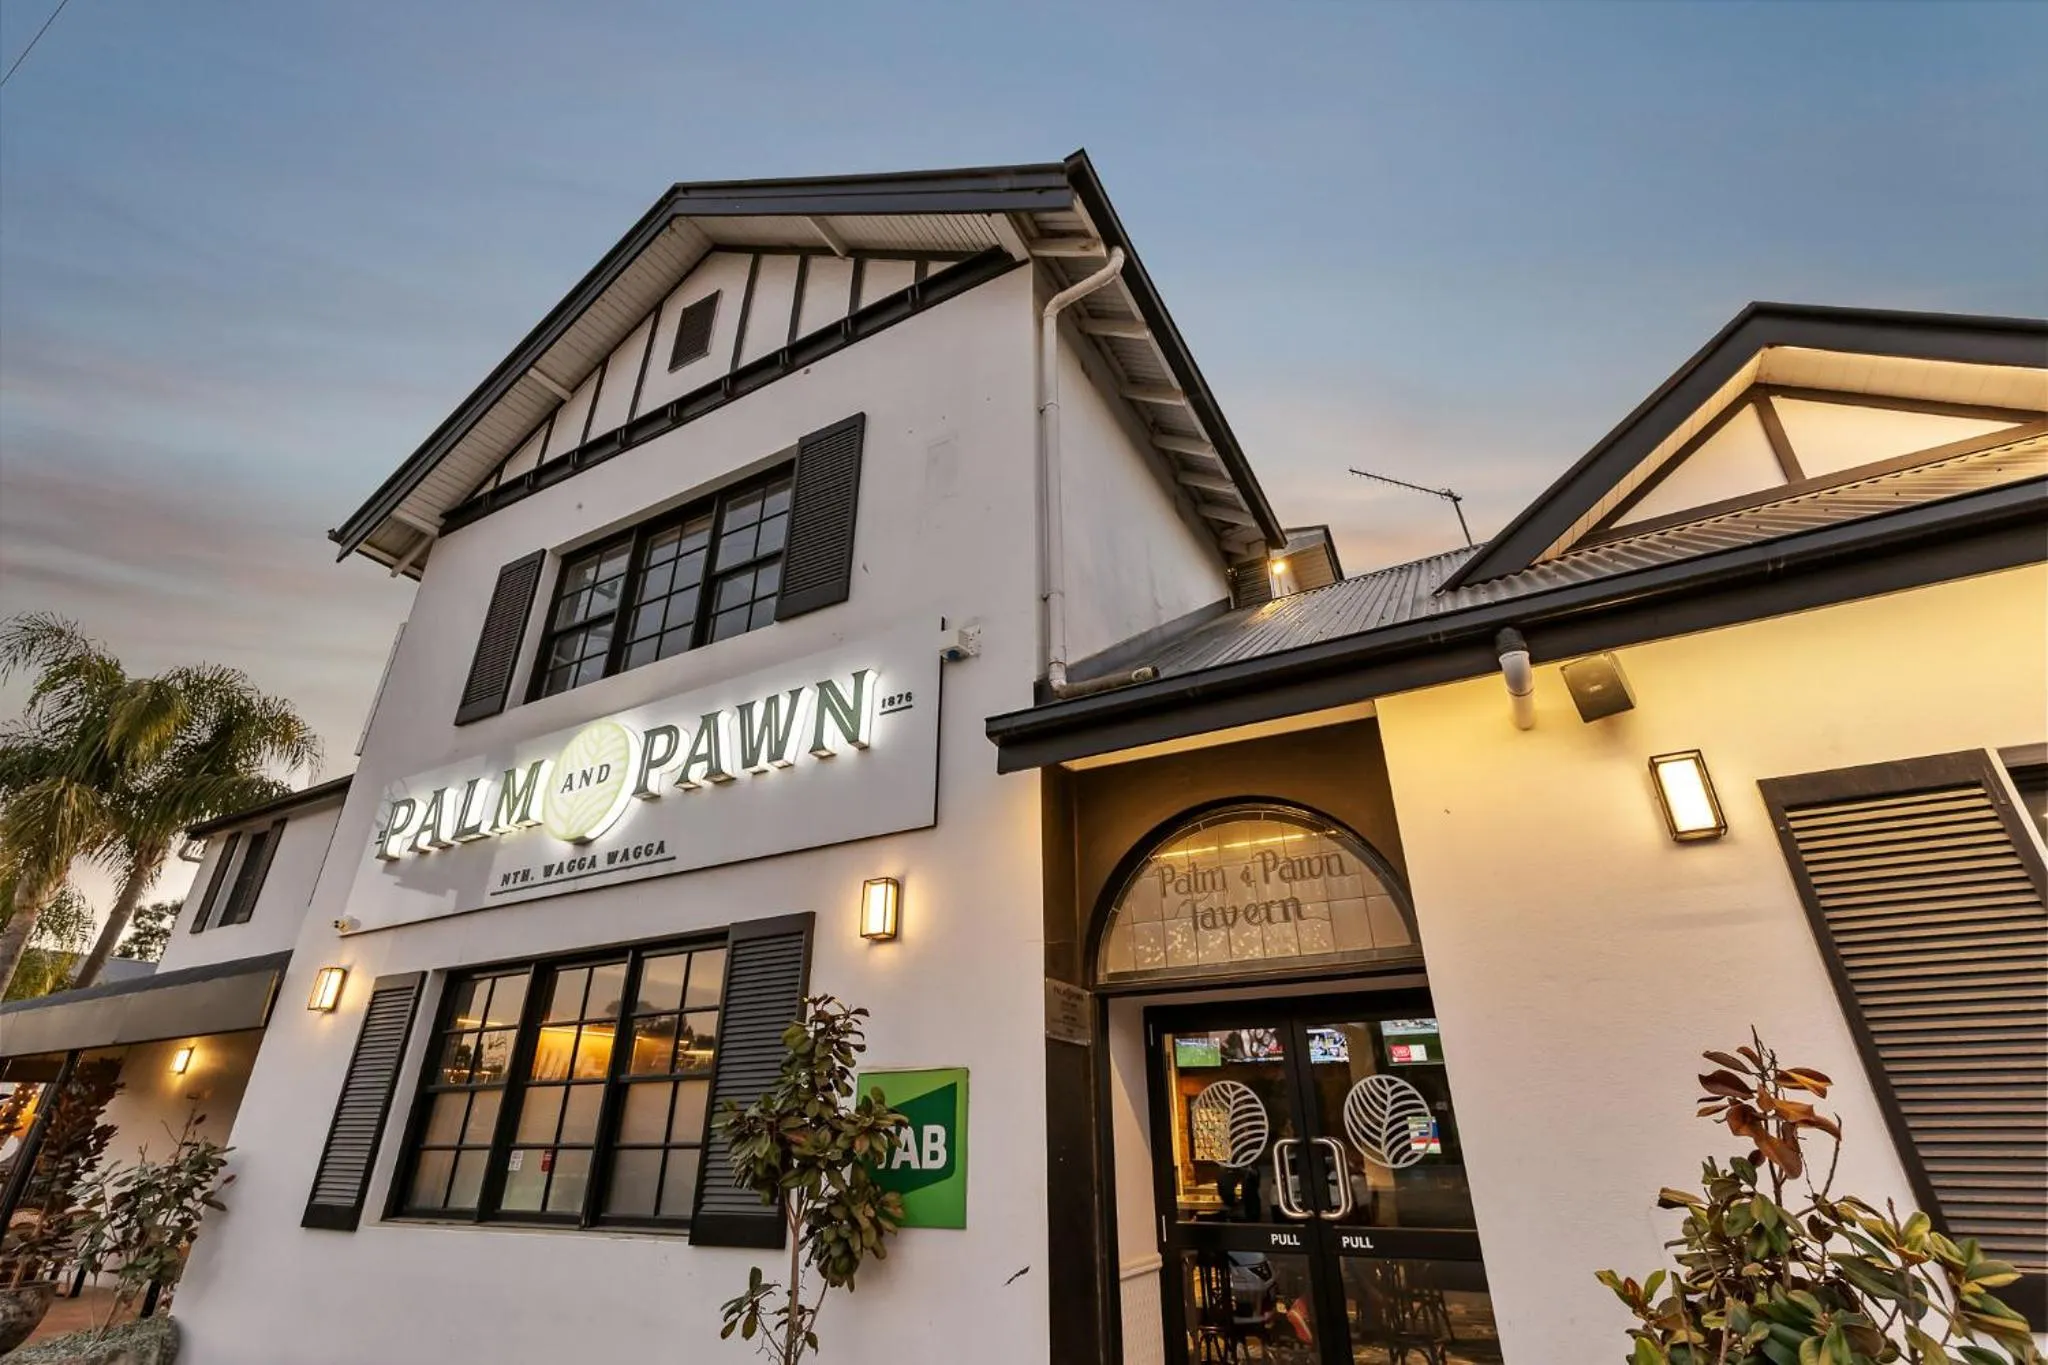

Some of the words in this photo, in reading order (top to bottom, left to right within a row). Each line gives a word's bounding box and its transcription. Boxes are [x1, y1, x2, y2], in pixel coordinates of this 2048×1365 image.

[881, 691, 913, 709] 1876
[375, 759, 550, 862] PALM
[560, 763, 611, 794] AND
[633, 668, 874, 800] PAWN
[500, 869, 535, 887] NTH.
[543, 855, 598, 878] WAGGA
[607, 840, 666, 866] WAGGA
[1153, 862, 1227, 898] Palm
[1254, 849, 1348, 885] Pawn
[1178, 895, 1316, 931] Tavern
[1270, 1233, 1301, 1246] PULL
[1341, 1236, 1374, 1249] PULL
